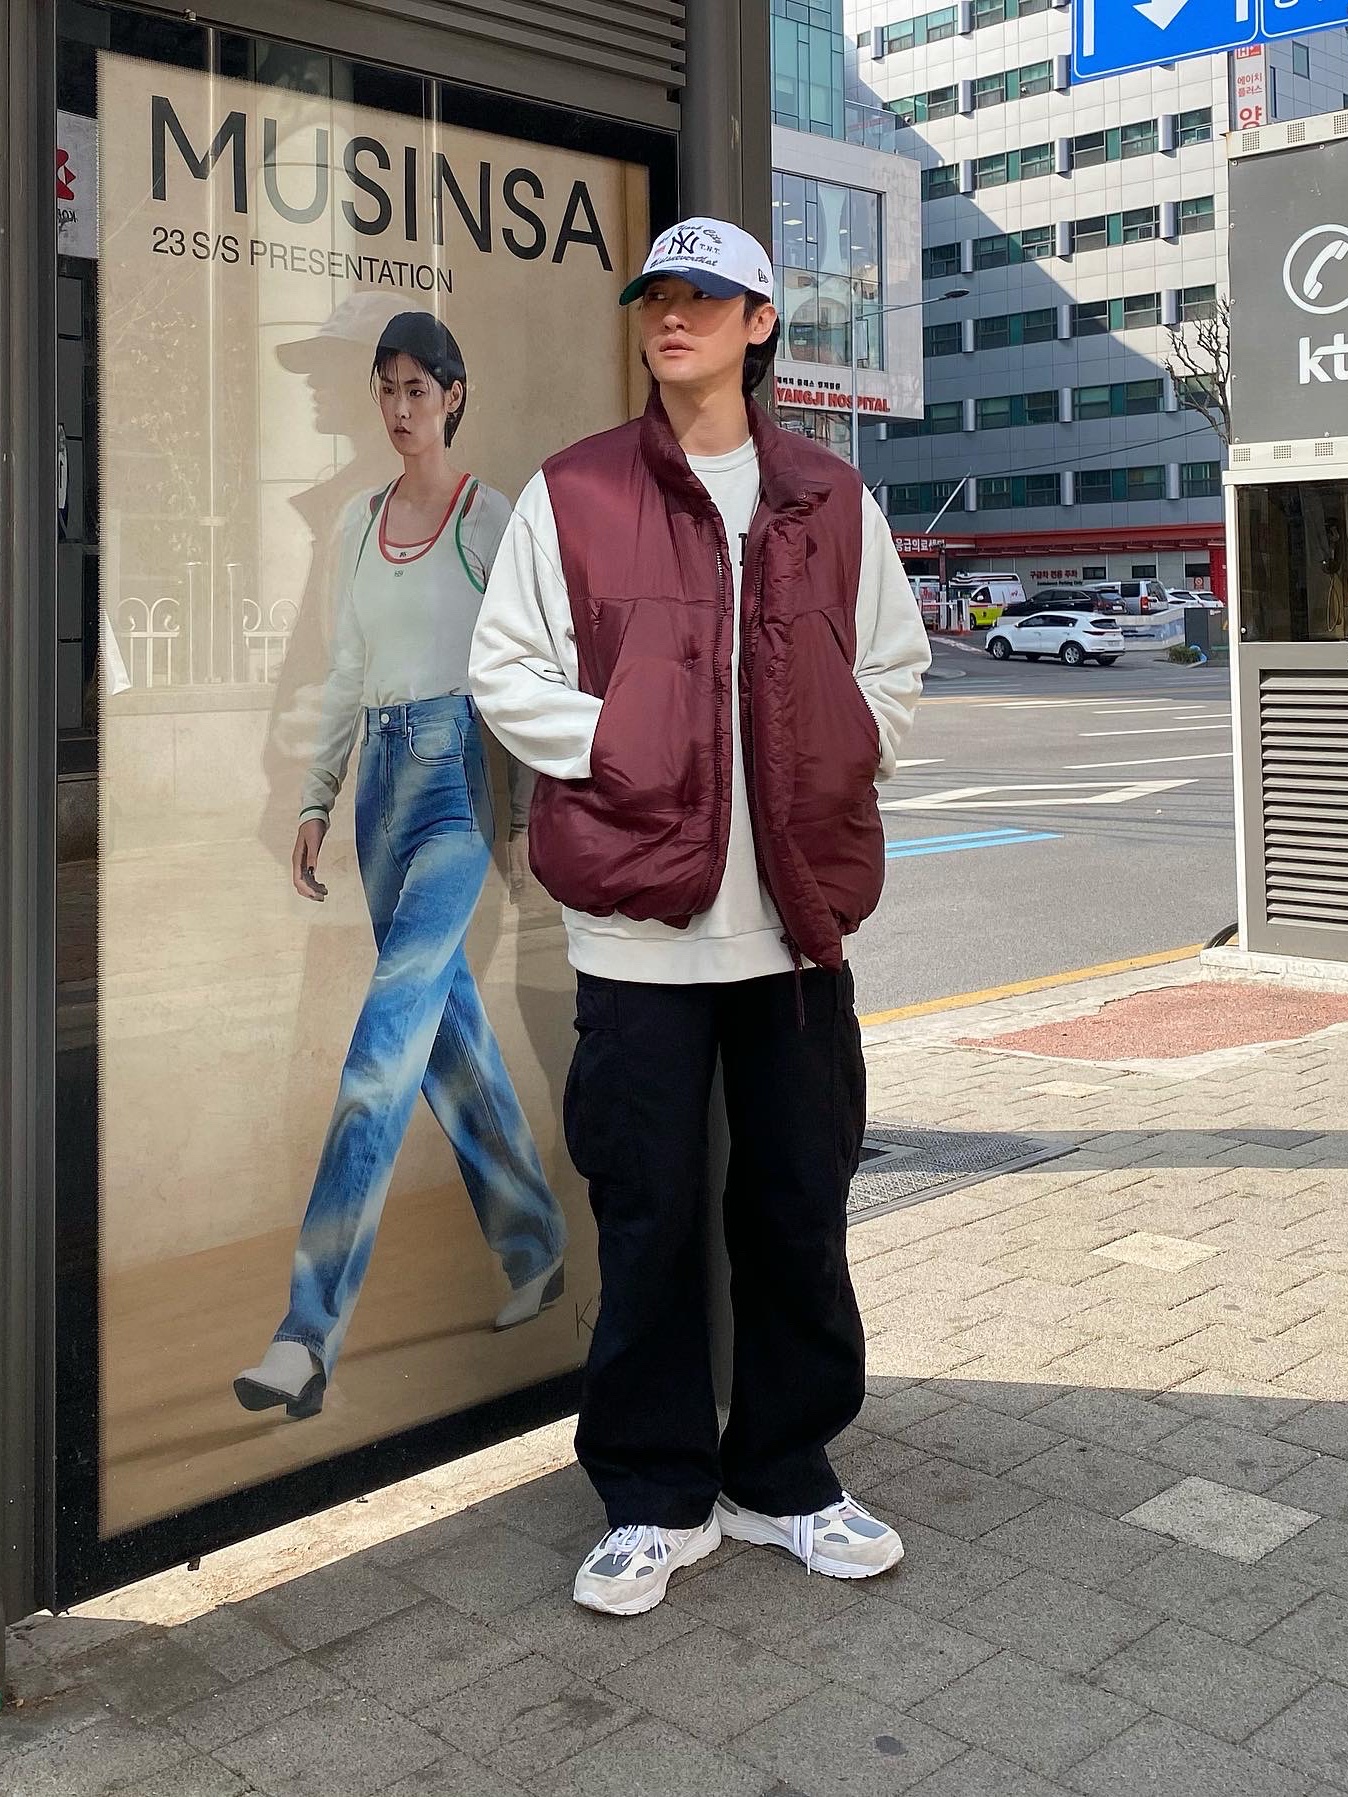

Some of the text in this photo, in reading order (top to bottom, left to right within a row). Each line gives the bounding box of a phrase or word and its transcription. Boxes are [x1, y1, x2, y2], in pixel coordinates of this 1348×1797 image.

[1237, 72, 1262, 85] 에이치
[1238, 86, 1263, 97] 플러스
[151, 95, 614, 272] MUSINSA
[667, 230, 700, 255] NY
[152, 226, 453, 294] 23 S/S PRESENTATION
[1299, 333, 1348, 384] kt
[776, 387, 891, 413] YANGJI HOSPITAL
